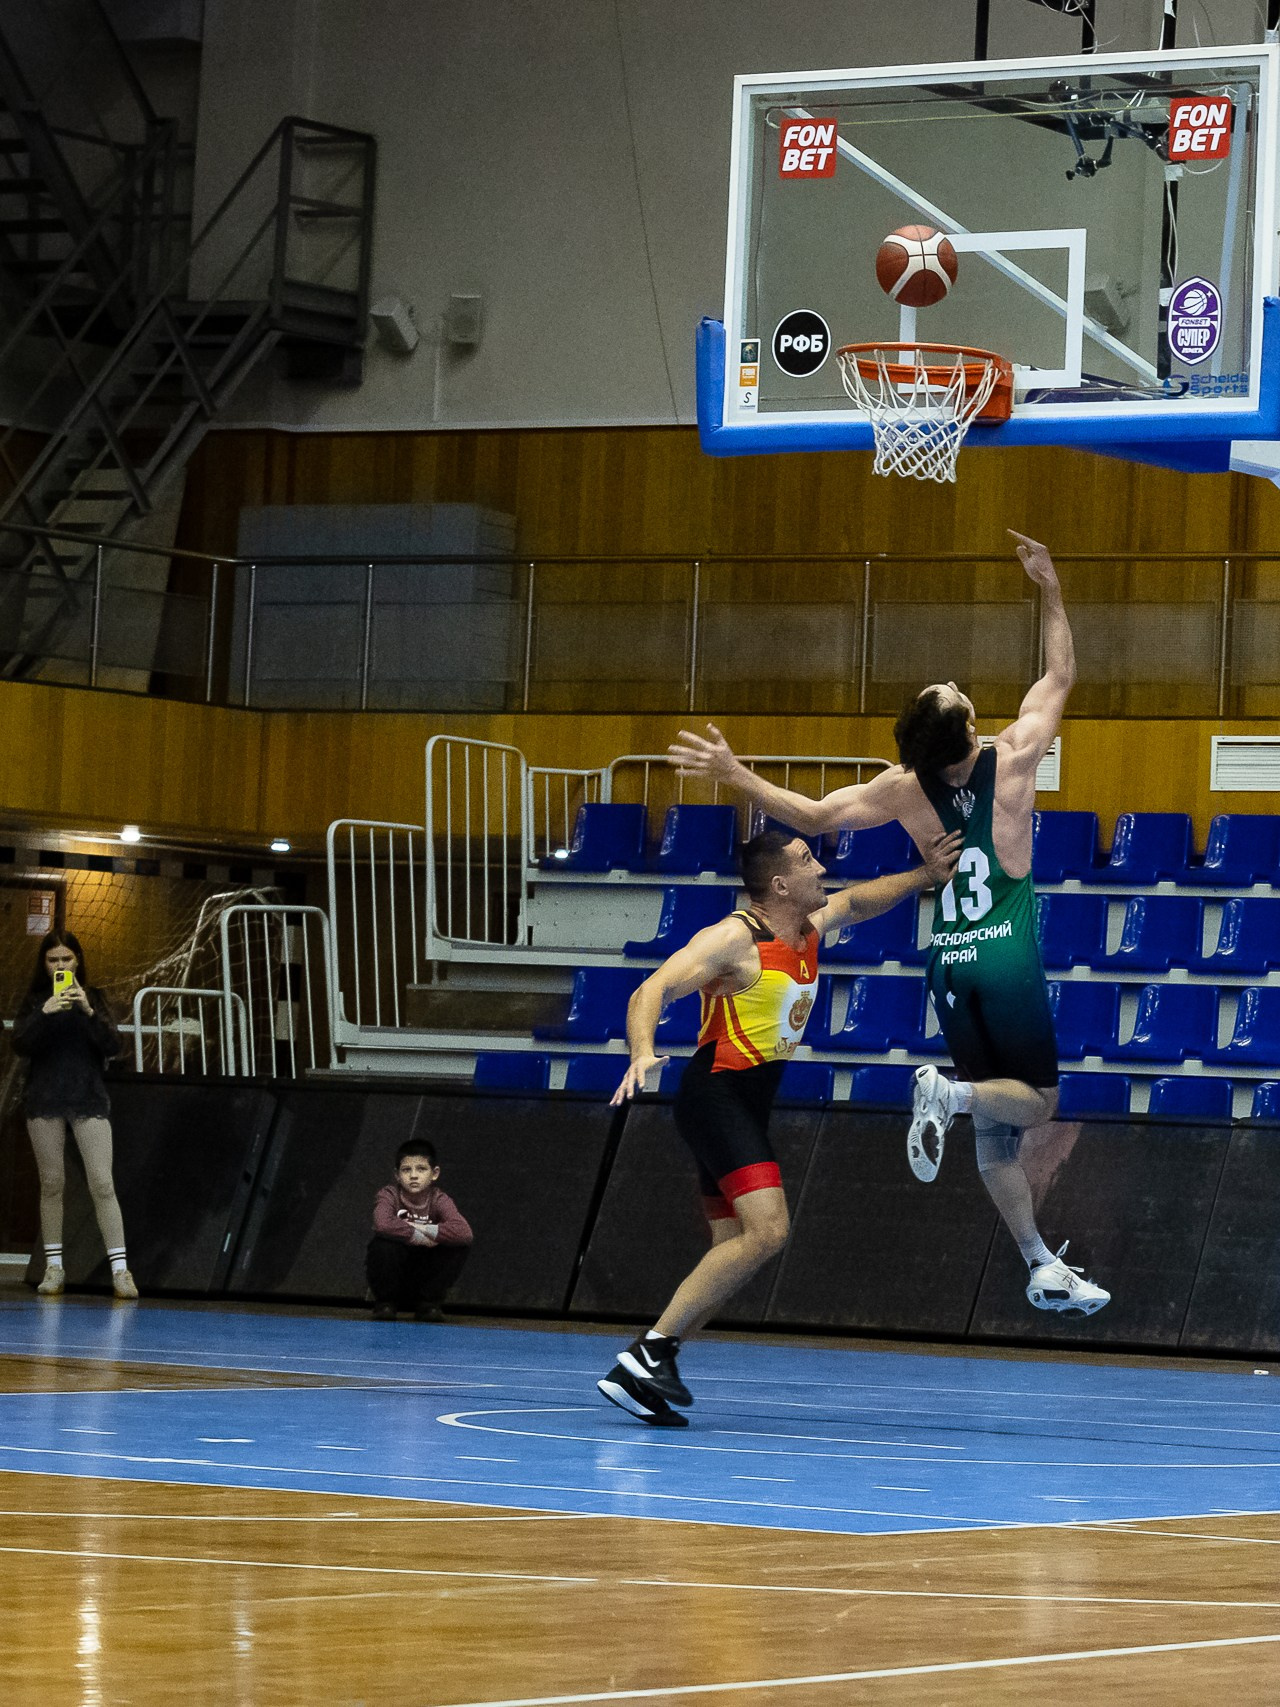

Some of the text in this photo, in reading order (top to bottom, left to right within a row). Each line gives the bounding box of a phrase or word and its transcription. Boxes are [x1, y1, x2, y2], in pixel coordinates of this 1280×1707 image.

[1173, 104, 1228, 127] FON
[783, 125, 835, 147] FON
[1172, 128, 1227, 152] BET
[782, 148, 834, 171] BET
[780, 334, 824, 353] РФБ
[1177, 328, 1210, 347] СУПЕР
[1190, 384, 1248, 395] Sports
[941, 847, 993, 921] 13
[941, 945, 977, 965] КРАЙ
